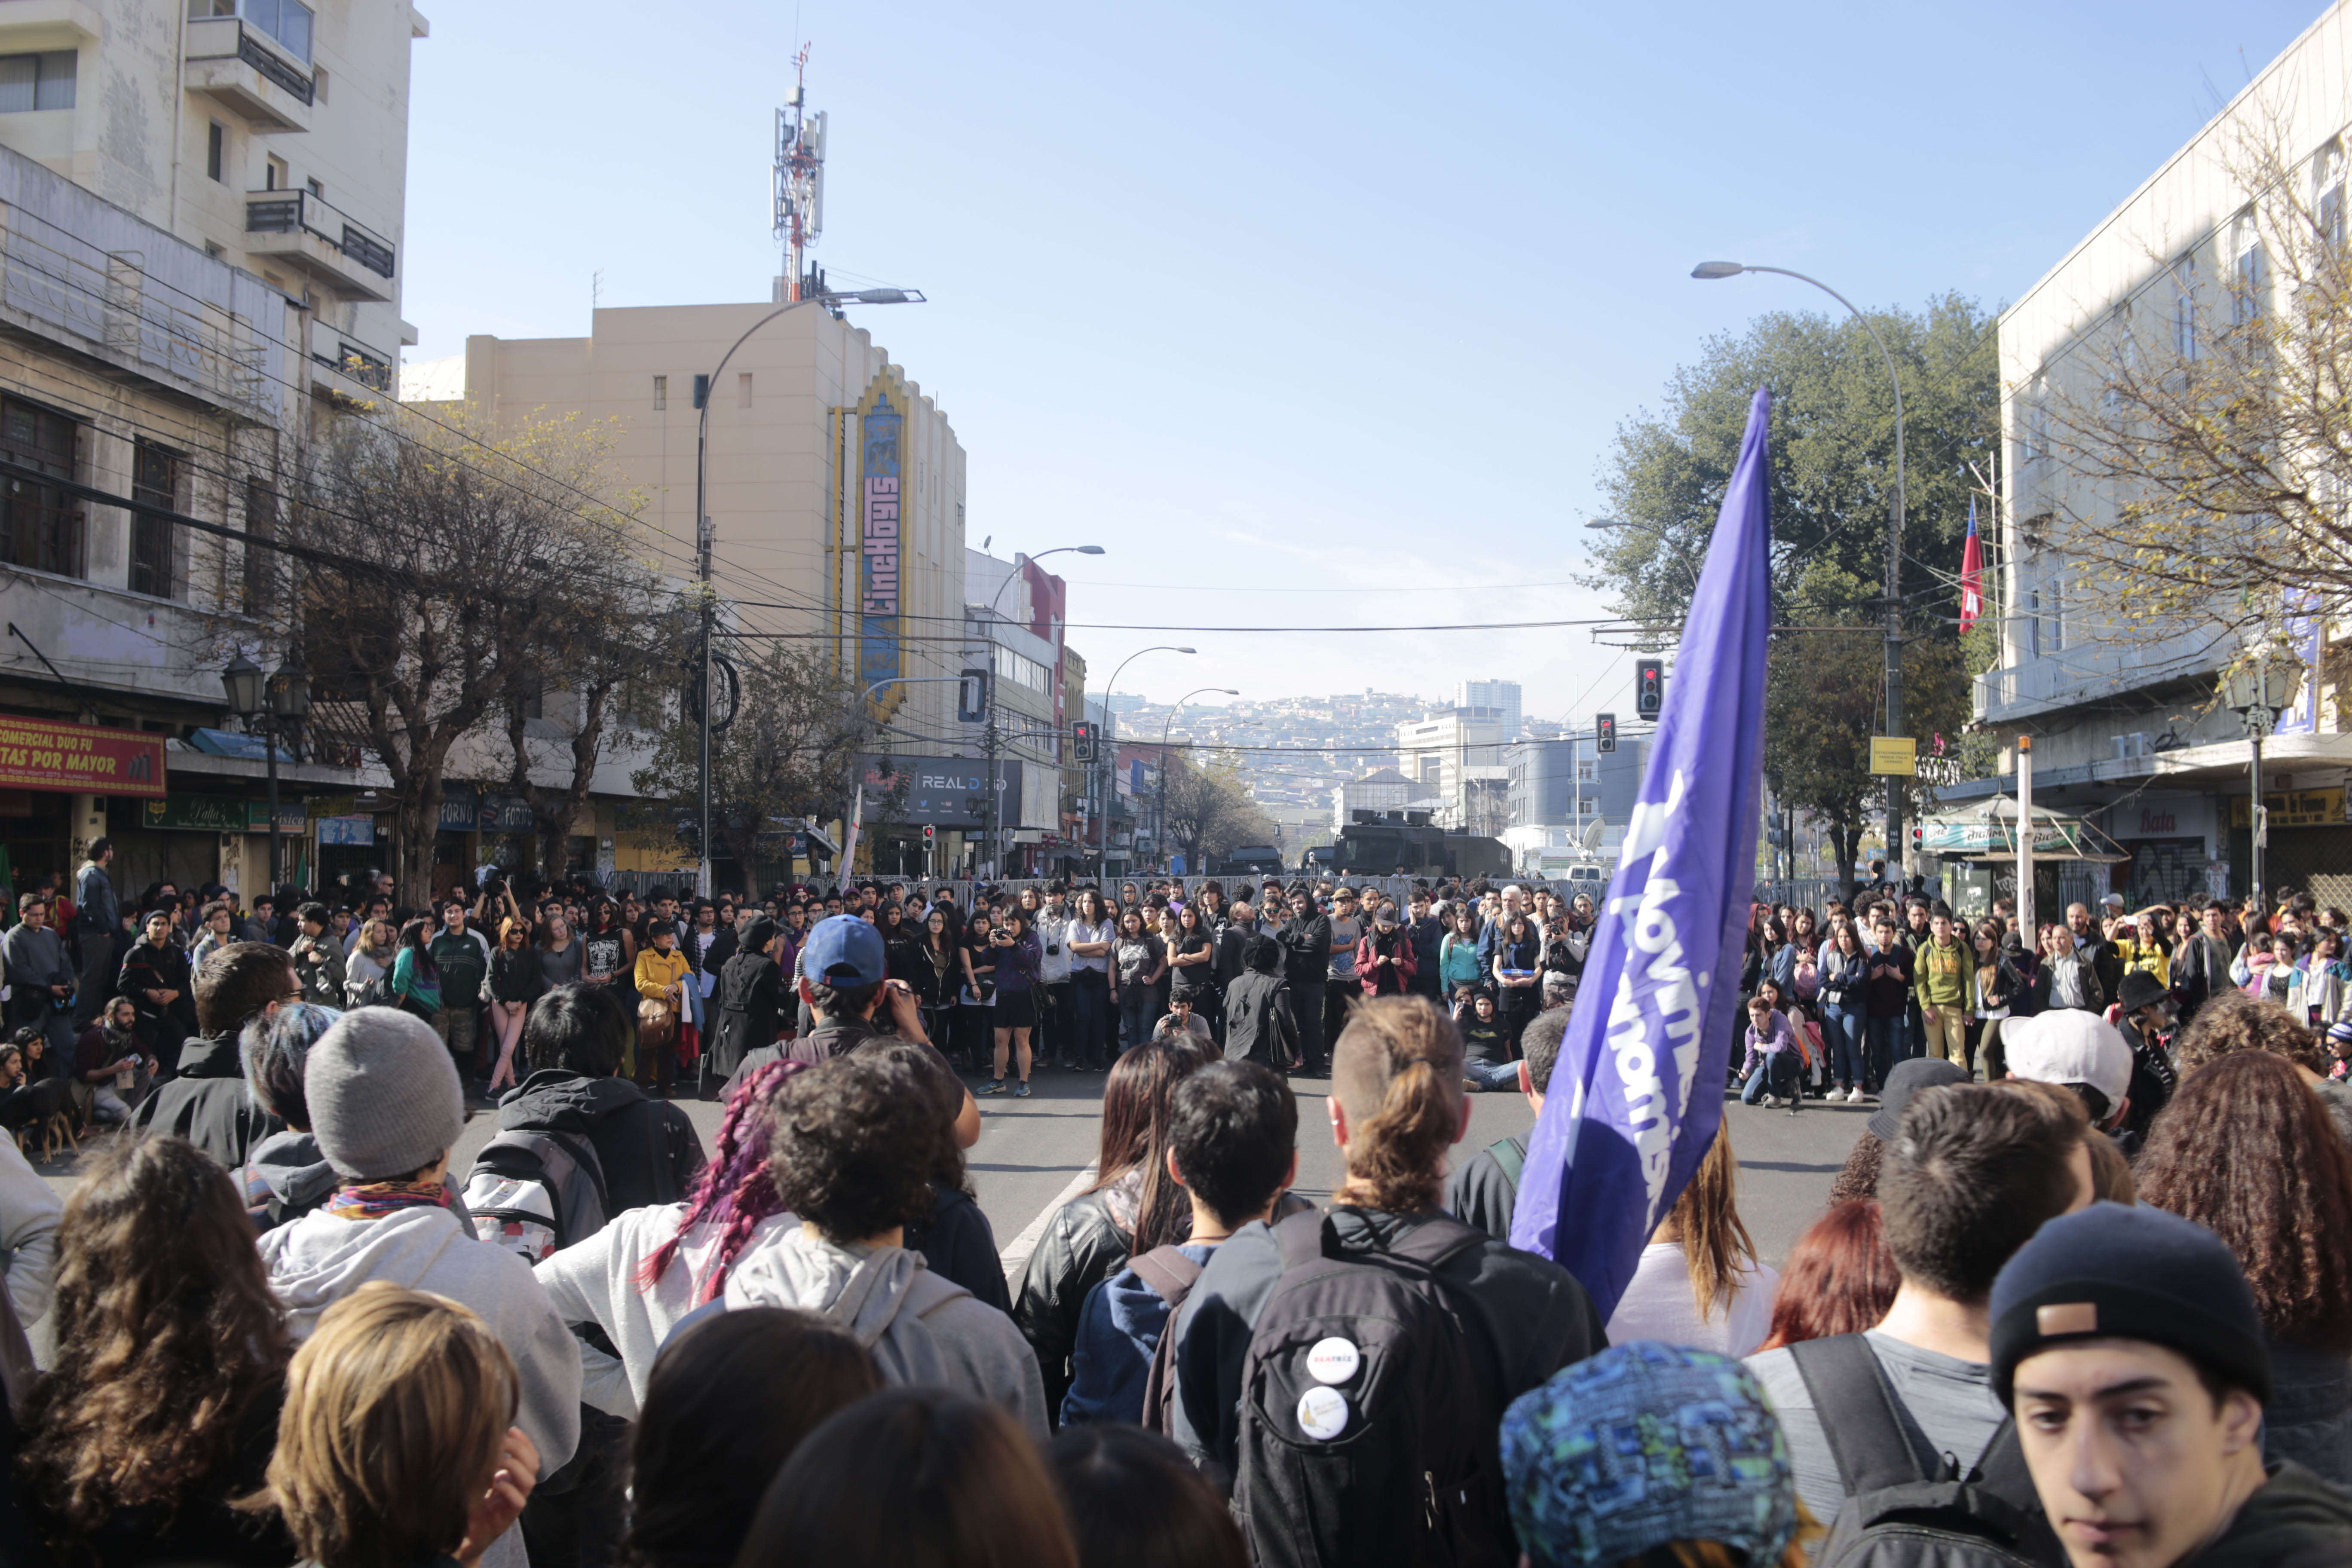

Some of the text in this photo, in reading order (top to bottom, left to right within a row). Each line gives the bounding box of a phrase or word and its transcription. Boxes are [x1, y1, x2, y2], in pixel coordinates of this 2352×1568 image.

[57, 735, 78, 750] DUO
[80, 738, 93, 751] FU
[31, 750, 63, 771] POR
[66, 753, 116, 775] MAYOR
[922, 775, 966, 790] REAL
[969, 778, 980, 790] D
[441, 802, 472, 824] FORNO
[505, 806, 533, 826] FORNO
[2139, 808, 2176, 833] Bata
[1500, 849, 1507, 865] 44
